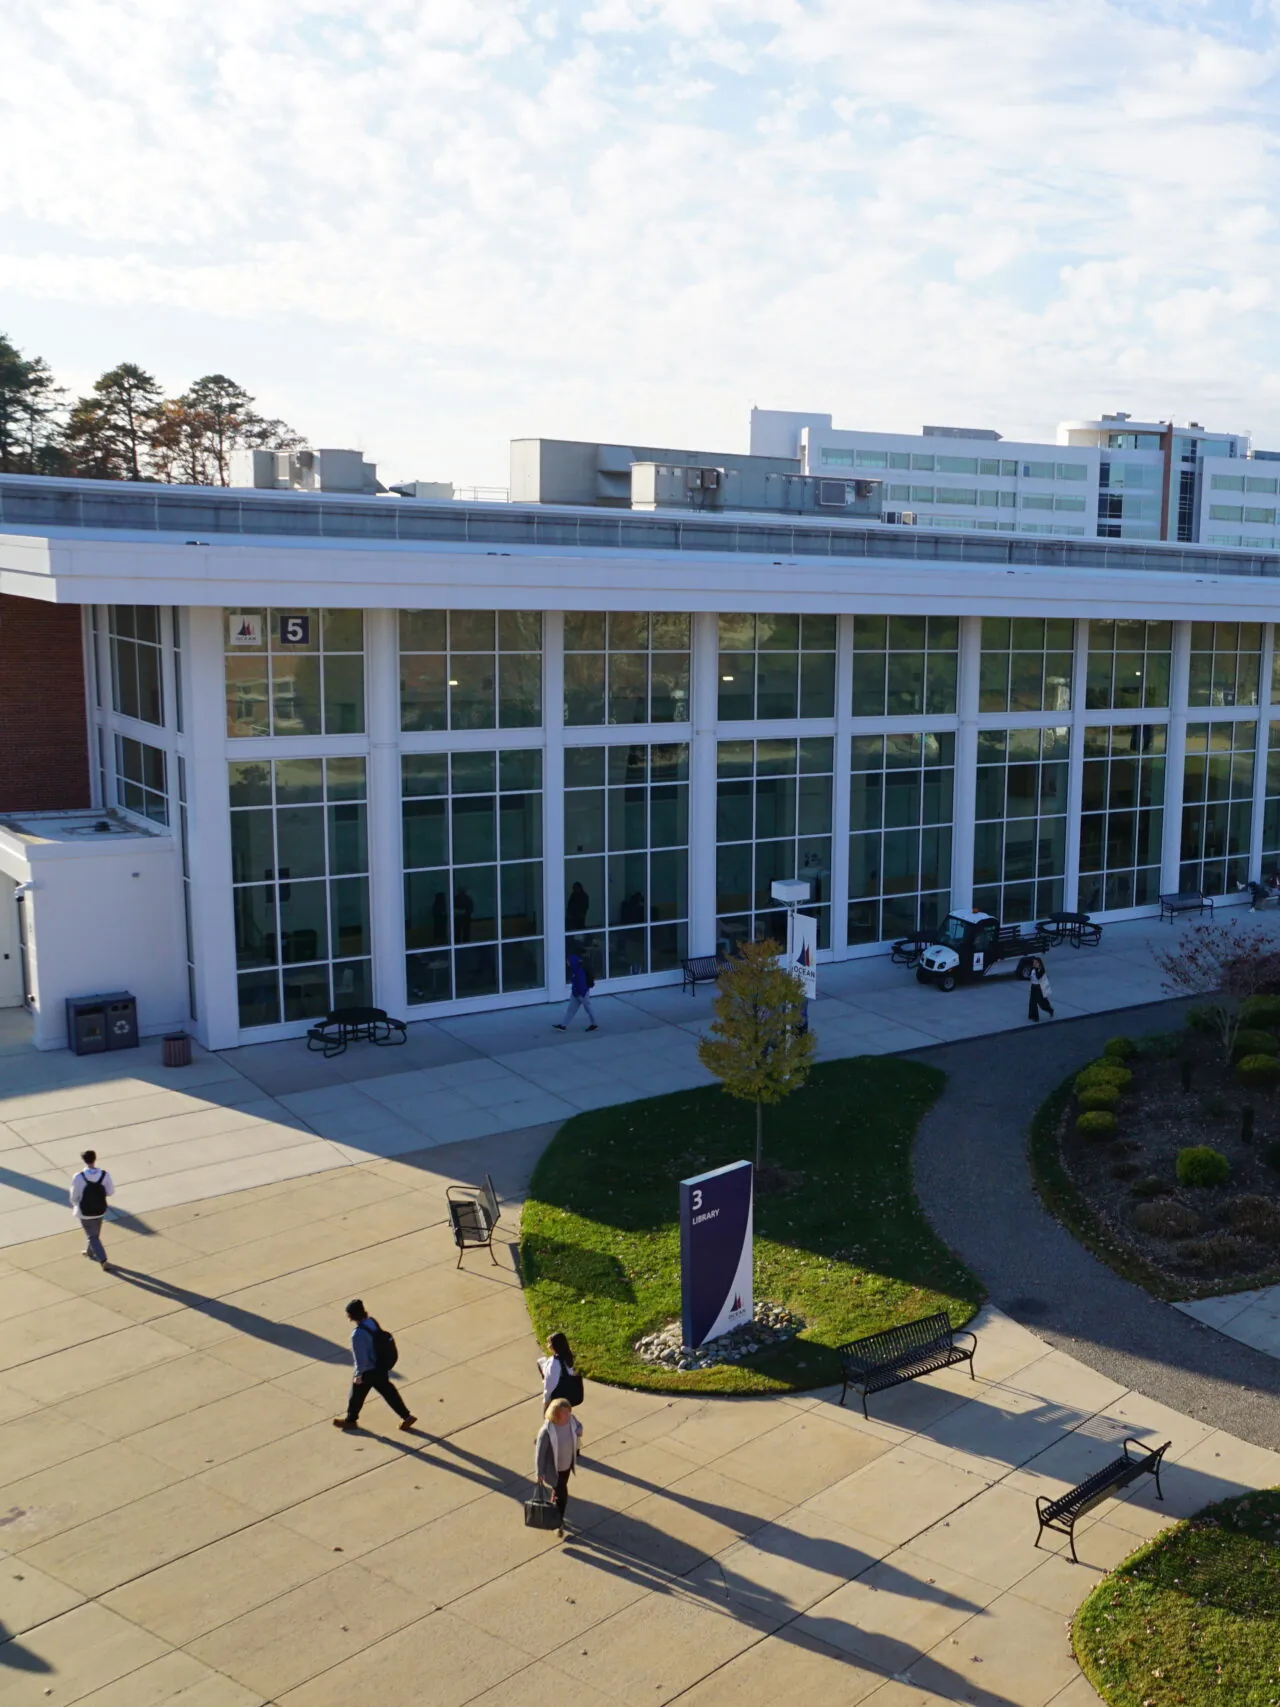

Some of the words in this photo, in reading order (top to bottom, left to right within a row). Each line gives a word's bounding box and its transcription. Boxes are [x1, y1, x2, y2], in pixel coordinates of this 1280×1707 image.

[286, 618, 303, 641] 5
[793, 965, 816, 979] OCEAN
[692, 1189, 703, 1211] 3
[692, 1208, 720, 1225] LIBRARY
